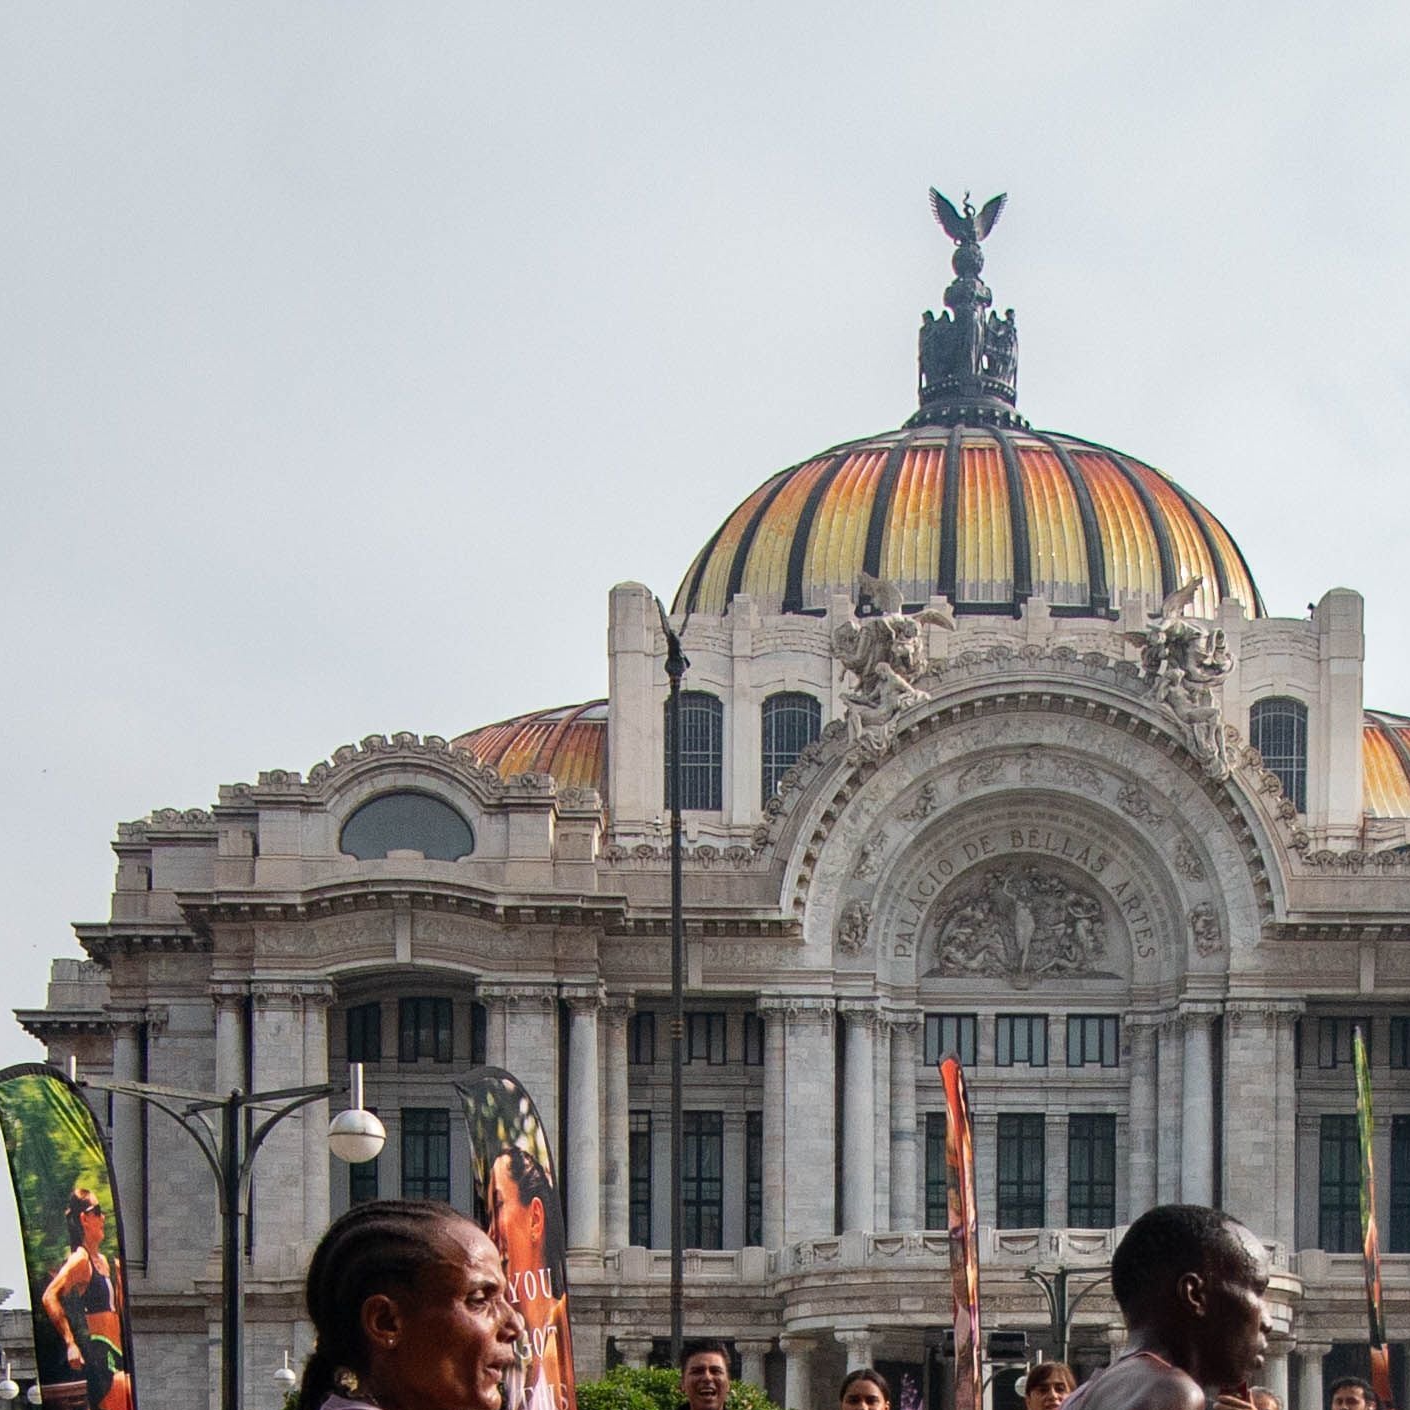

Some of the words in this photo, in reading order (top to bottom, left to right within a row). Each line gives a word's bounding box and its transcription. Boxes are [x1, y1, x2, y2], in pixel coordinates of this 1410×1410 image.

[893, 859, 954, 959] PALACIO
[962, 834, 995, 862] DE
[1010, 829, 1108, 874] BELLAS
[1111, 879, 1156, 960] ARTES
[507, 1267, 553, 1304] YOU
[513, 1326, 557, 1361] GOT
